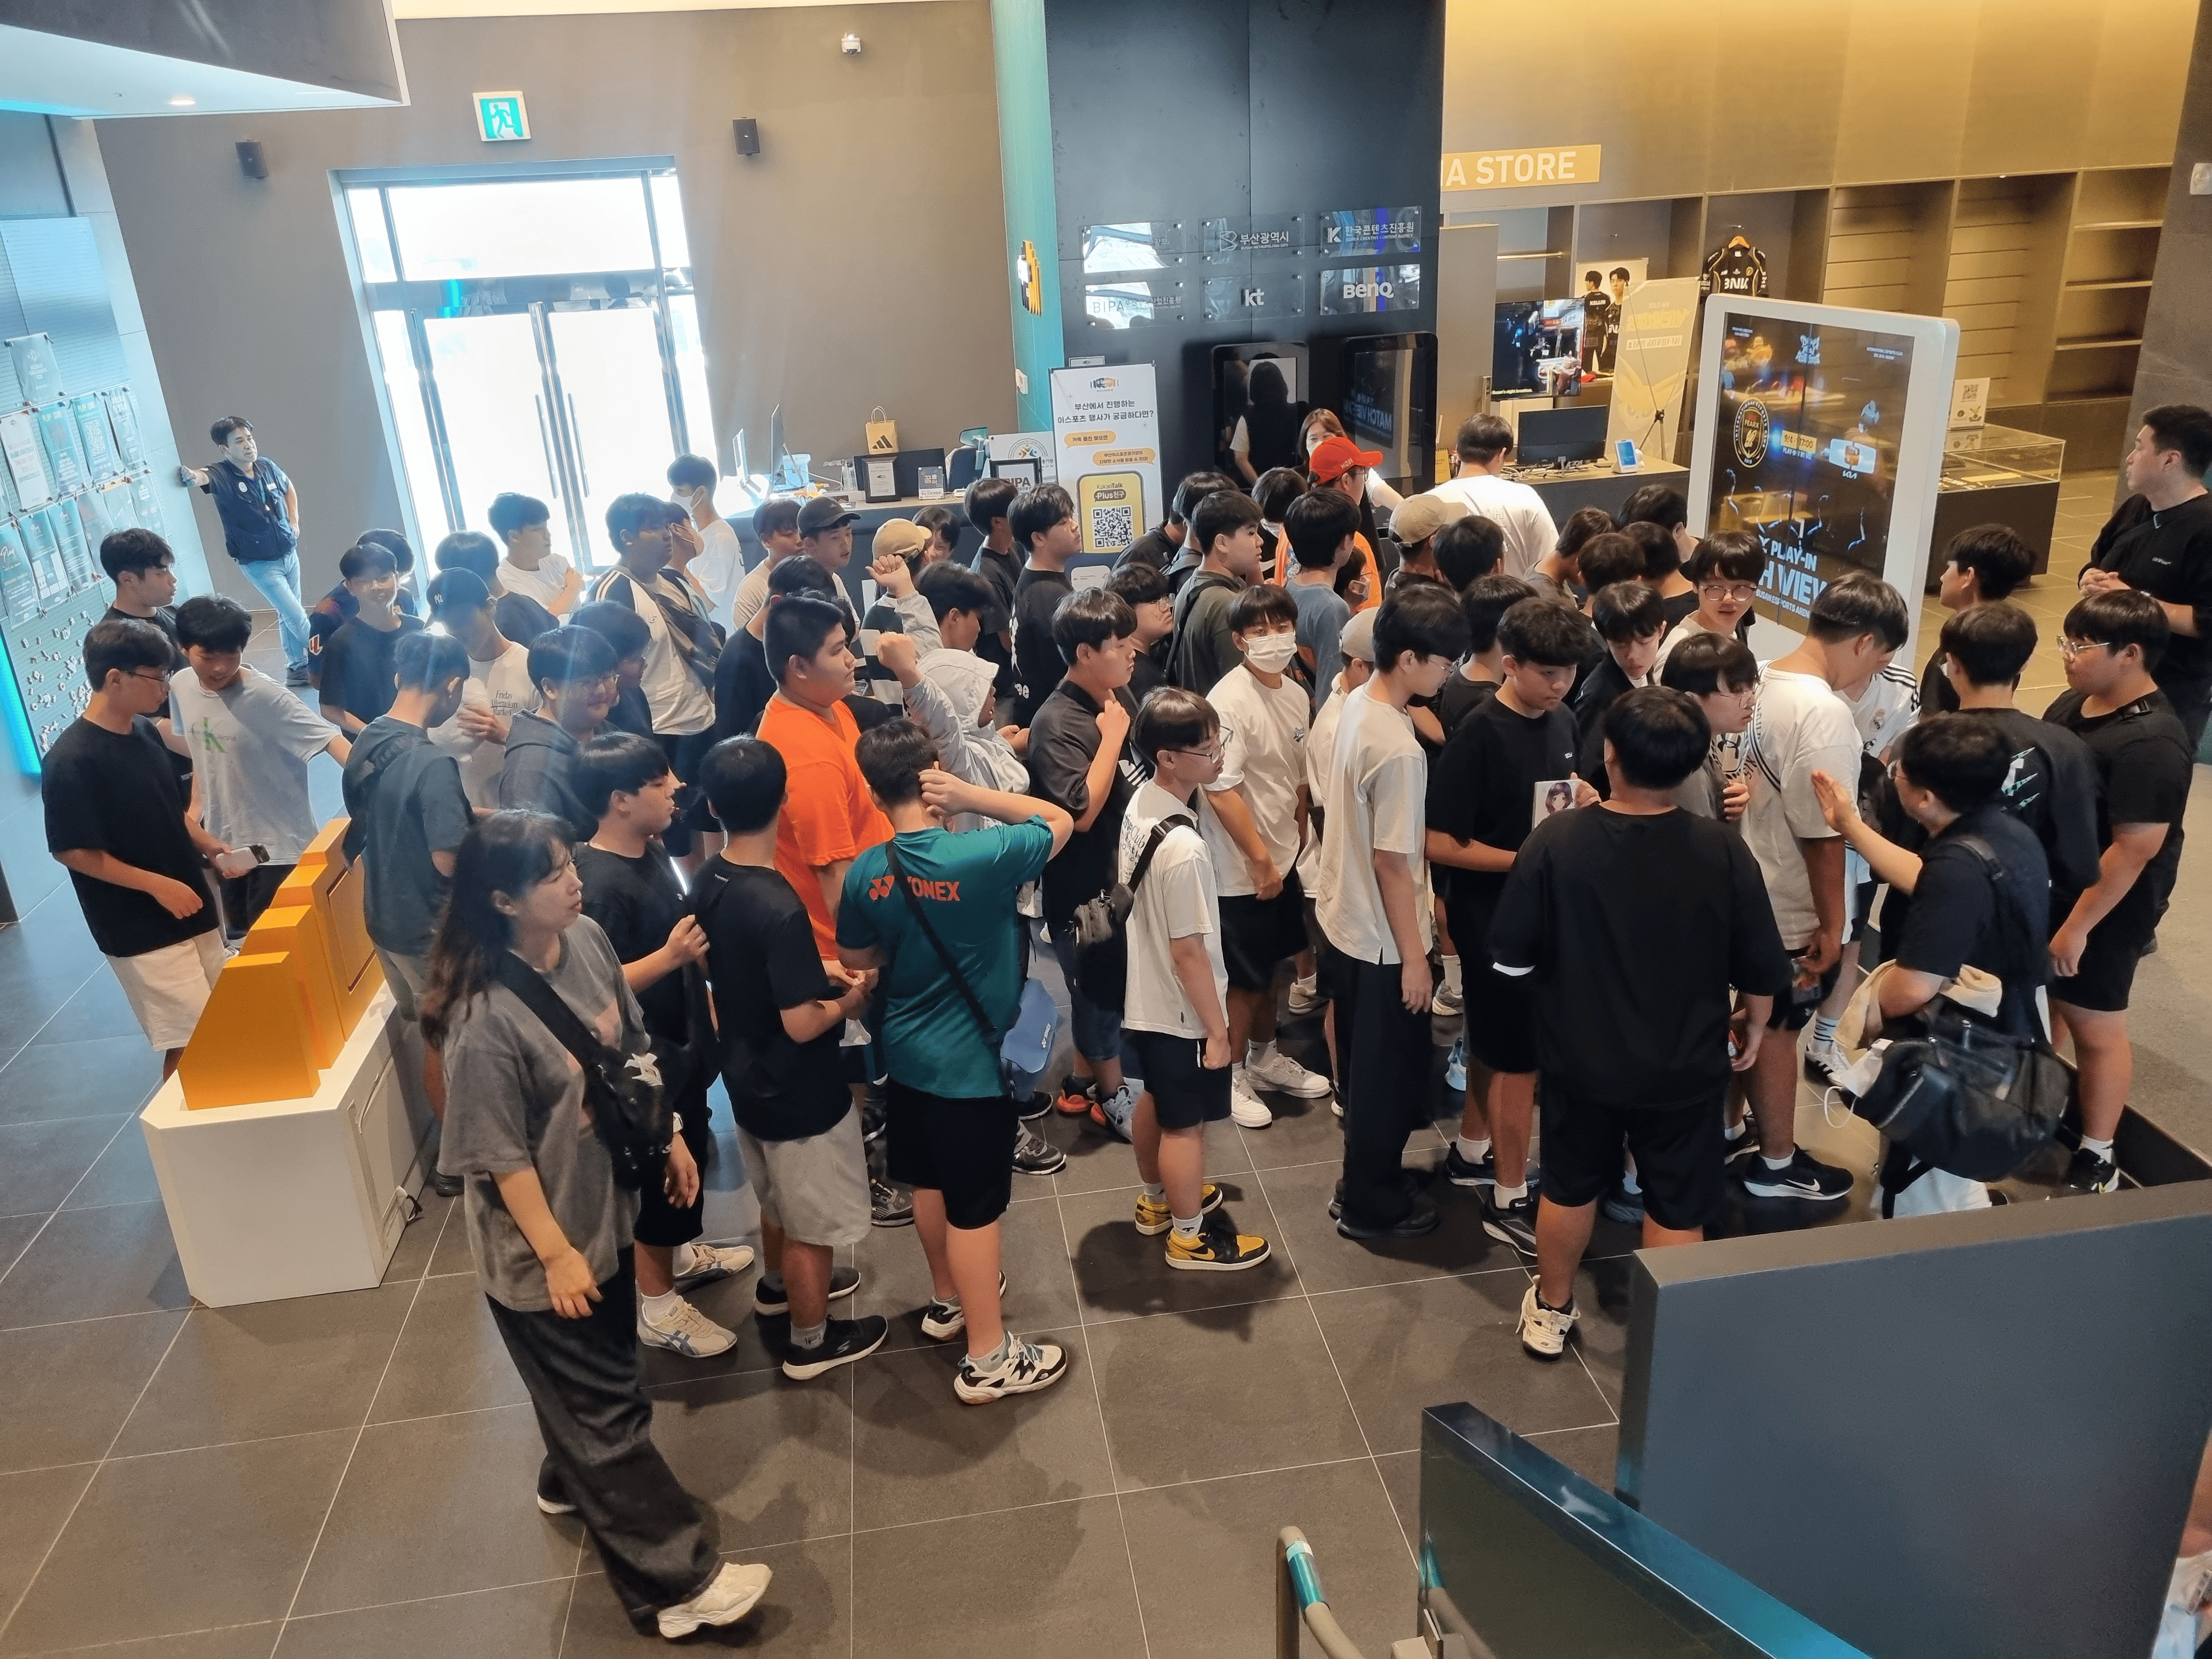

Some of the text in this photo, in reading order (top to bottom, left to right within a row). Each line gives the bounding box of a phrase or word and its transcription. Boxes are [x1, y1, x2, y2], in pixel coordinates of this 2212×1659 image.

[1441, 151, 1576, 187] A STORE
[1345, 222, 1414, 236] 한국콘텐츠진흥원
[1240, 231, 1289, 245] 부산광역시
[1245, 289, 1264, 306] kt
[1344, 282, 1394, 298] BenQ
[1093, 301, 1125, 313] BIPA
[1075, 400, 1135, 410] 부산에서 진행하는
[1058, 410, 1154, 424] 이스포츠 행사가 궁금하다면?
[1771, 540, 1817, 572] PLAY-IN
[907, 876, 961, 901] ONEX
